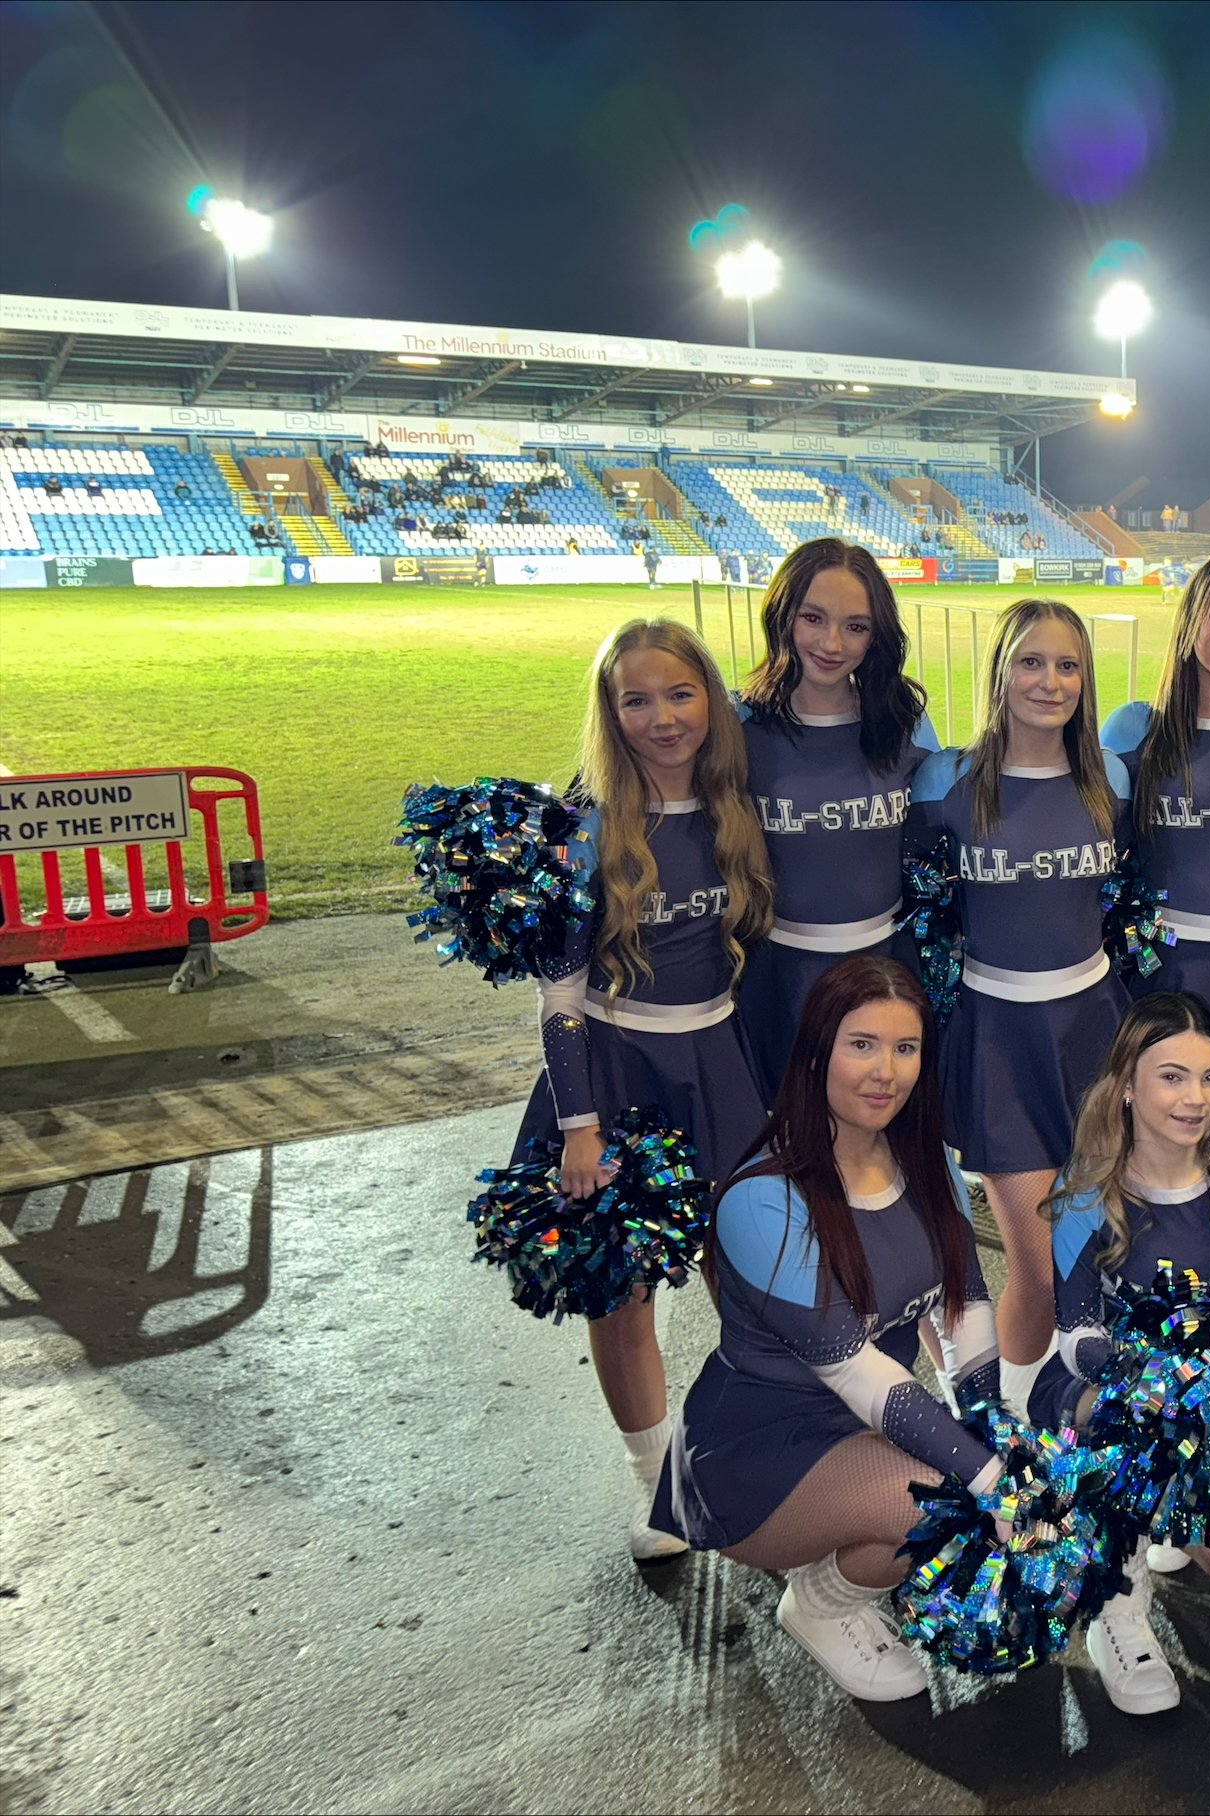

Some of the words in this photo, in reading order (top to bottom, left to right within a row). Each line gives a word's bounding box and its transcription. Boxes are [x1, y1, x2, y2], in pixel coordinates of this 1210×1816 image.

[402, 334, 436, 351] The
[441, 337, 533, 357] Millennium
[539, 343, 607, 362] Stadium
[49, 402, 116, 423] DJL
[171, 407, 235, 427] DJL
[286, 412, 345, 431] DJL
[378, 426, 475, 447] Millennium
[539, 424, 589, 441] DJL
[629, 428, 677, 445] DJL
[713, 431, 758, 448] DJL
[793, 437, 835, 453] DJL
[867, 439, 907, 456] DJL
[938, 443, 976, 459] DJL
[56, 558, 97, 568] BRAINS
[900, 560, 921, 568] CARS
[57, 567, 88, 577] PURE
[57, 577, 83, 587] CBD
[0, 791, 28, 811] LK
[36, 786, 132, 809] AROUND
[757, 787, 911, 834] LL-STAR
[19, 821, 48, 840] OF
[56, 817, 102, 837] THE
[110, 812, 175, 833] PITCH
[960, 840, 1117, 884] ALL-STAR
